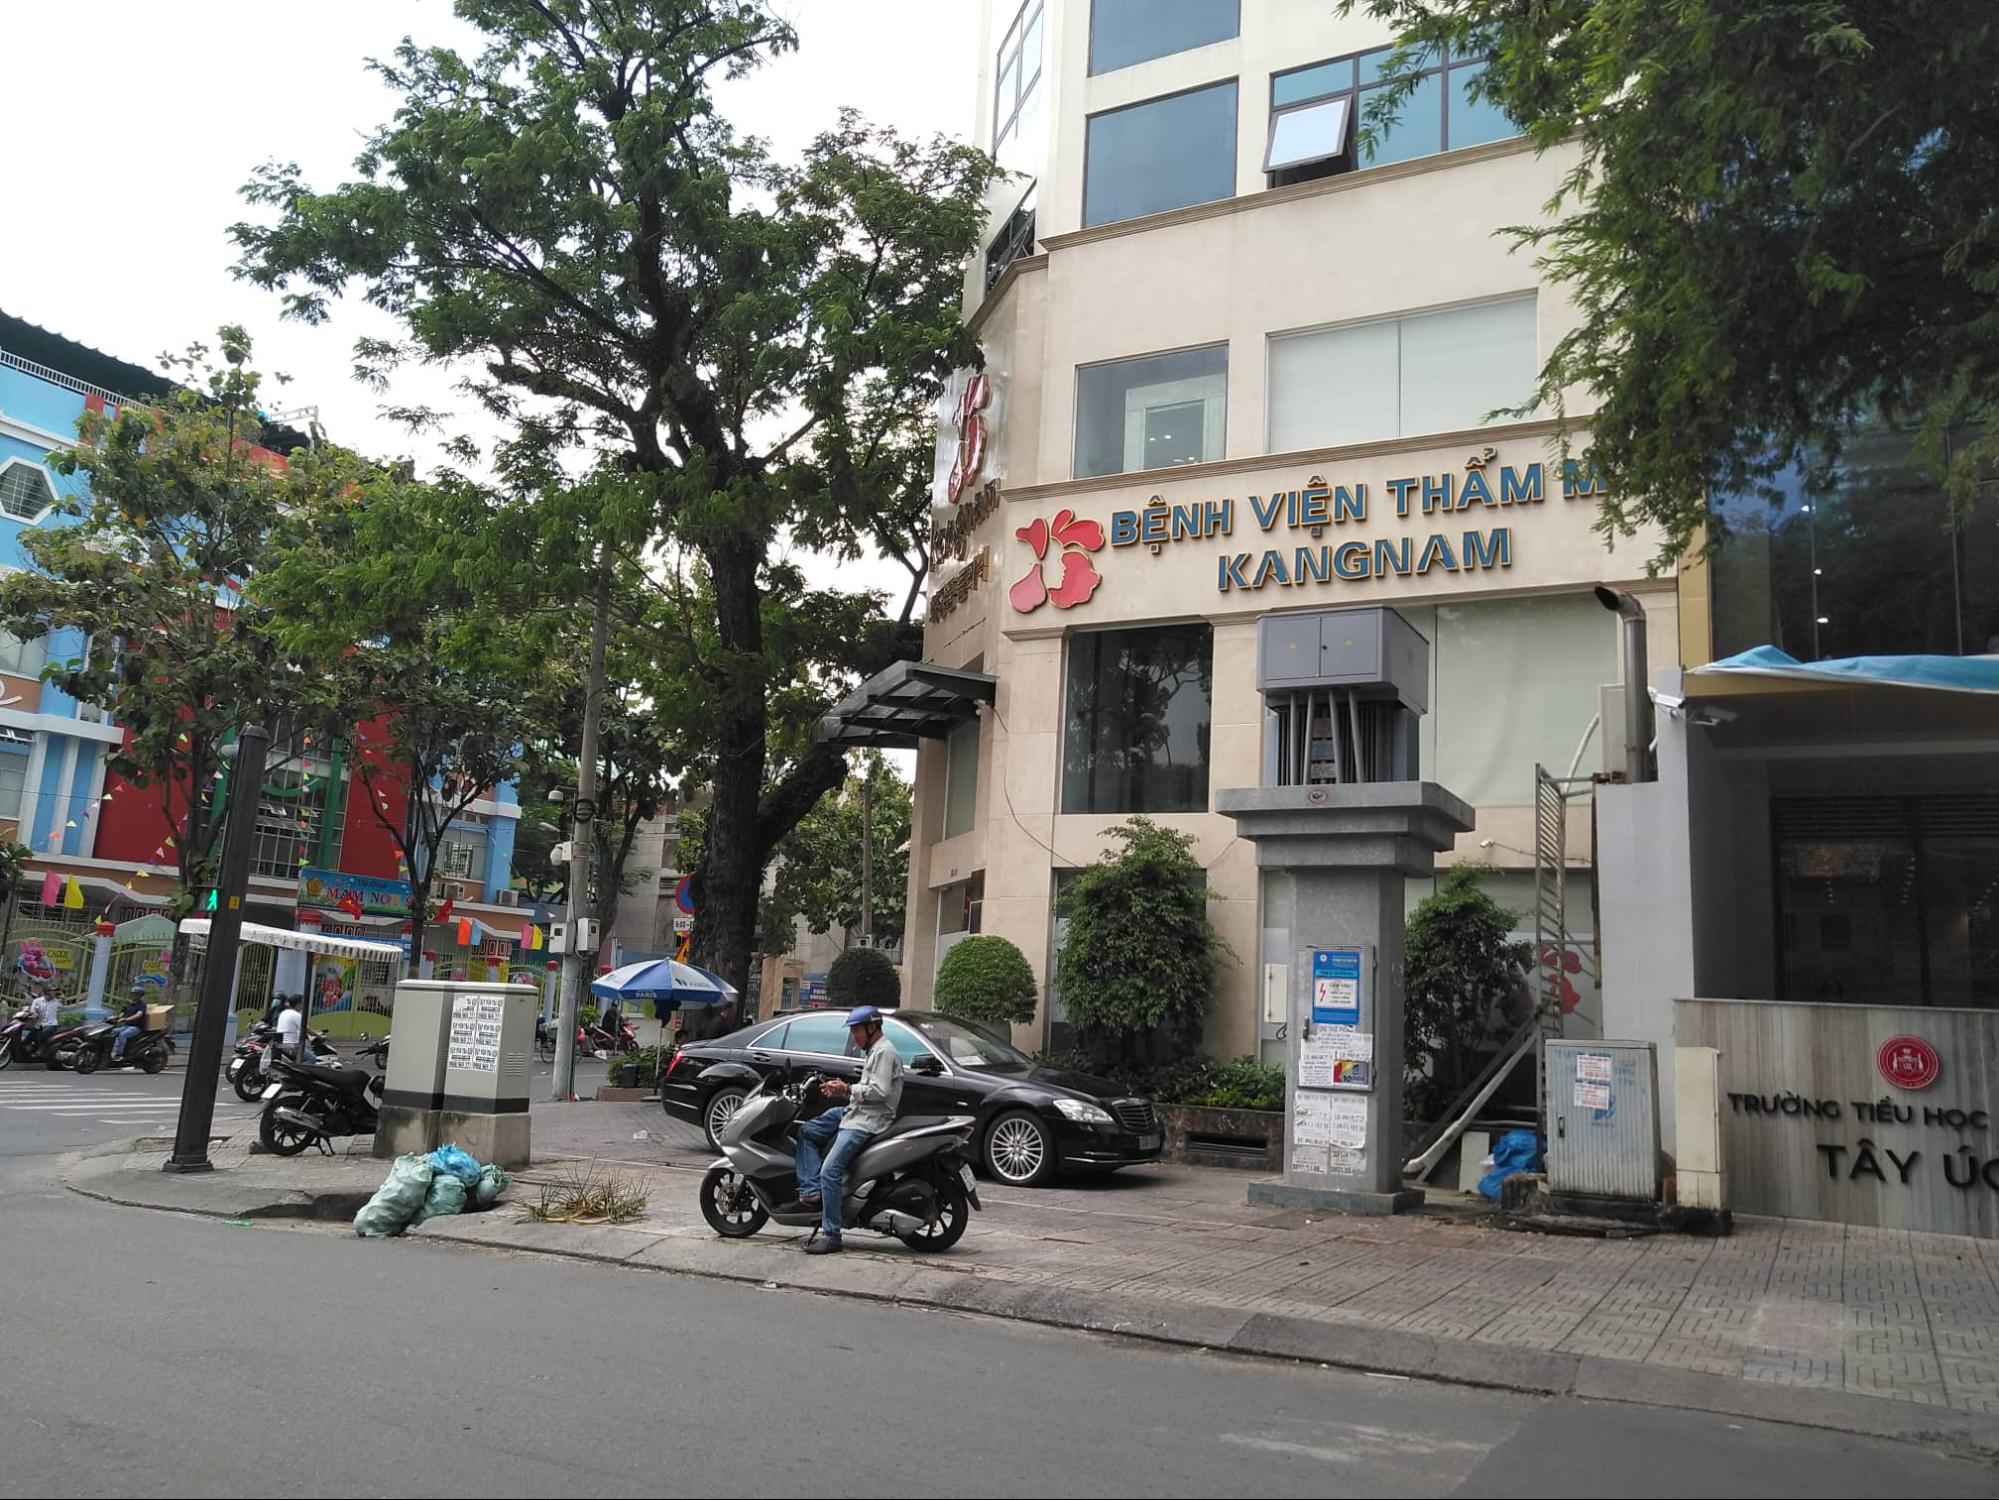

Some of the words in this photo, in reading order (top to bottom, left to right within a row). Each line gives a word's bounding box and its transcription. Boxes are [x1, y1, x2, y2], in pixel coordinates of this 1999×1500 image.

[1111, 494, 1233, 554] BỆNH
[1249, 475, 1367, 537] VIỆN
[1386, 446, 1545, 516] THẨM
[1563, 458, 1608, 499] M
[1217, 527, 1512, 591] KANGNAM
[1727, 1090, 1842, 1120] TRƯỜNG
[1851, 1096, 1914, 1125] TIỂU
[1924, 1105, 1990, 1133] HỌC
[1816, 1138, 1921, 1185] TÂY
